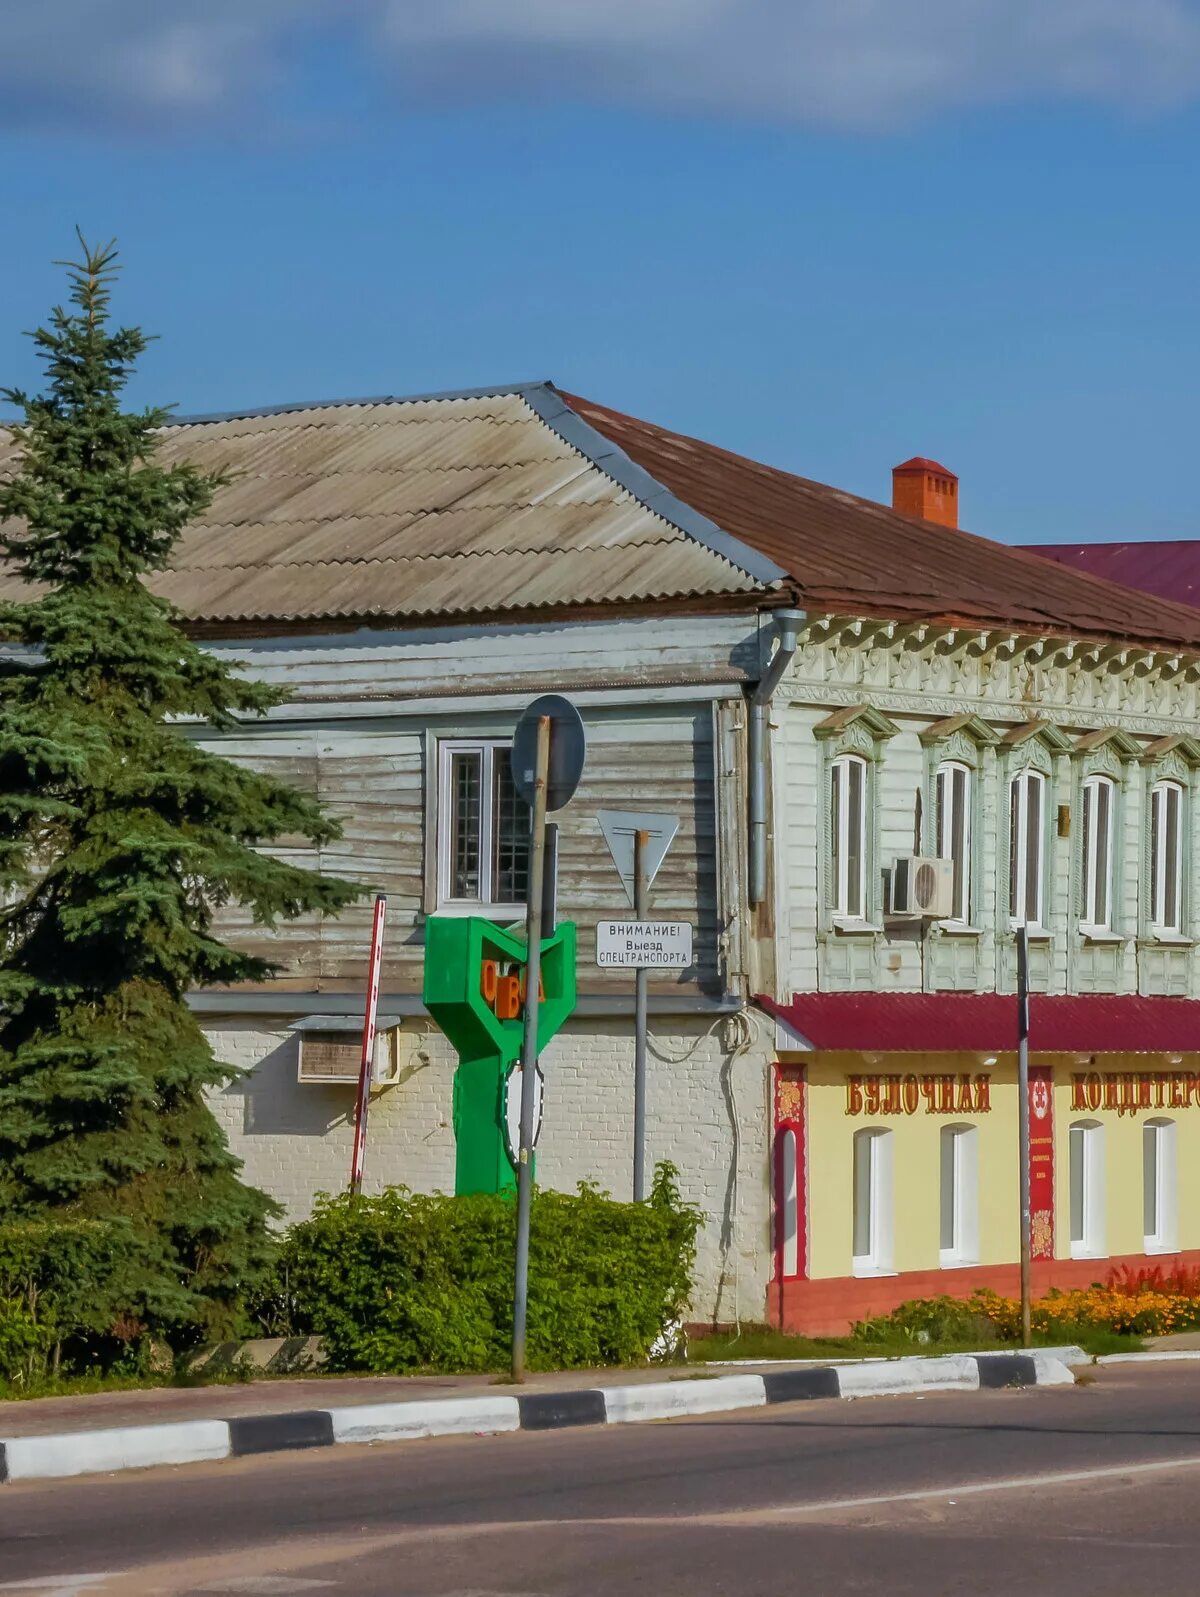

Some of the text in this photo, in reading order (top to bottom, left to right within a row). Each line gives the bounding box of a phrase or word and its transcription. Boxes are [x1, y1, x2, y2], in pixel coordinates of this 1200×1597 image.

[609, 925, 681, 936] ВНИМАНИЕ!
[626, 940, 663, 951] Выезд
[599, 952, 687, 963] СПЕЦТРАНСПОРТА
[845, 1073, 992, 1116] БУЛОЧНАЯ
